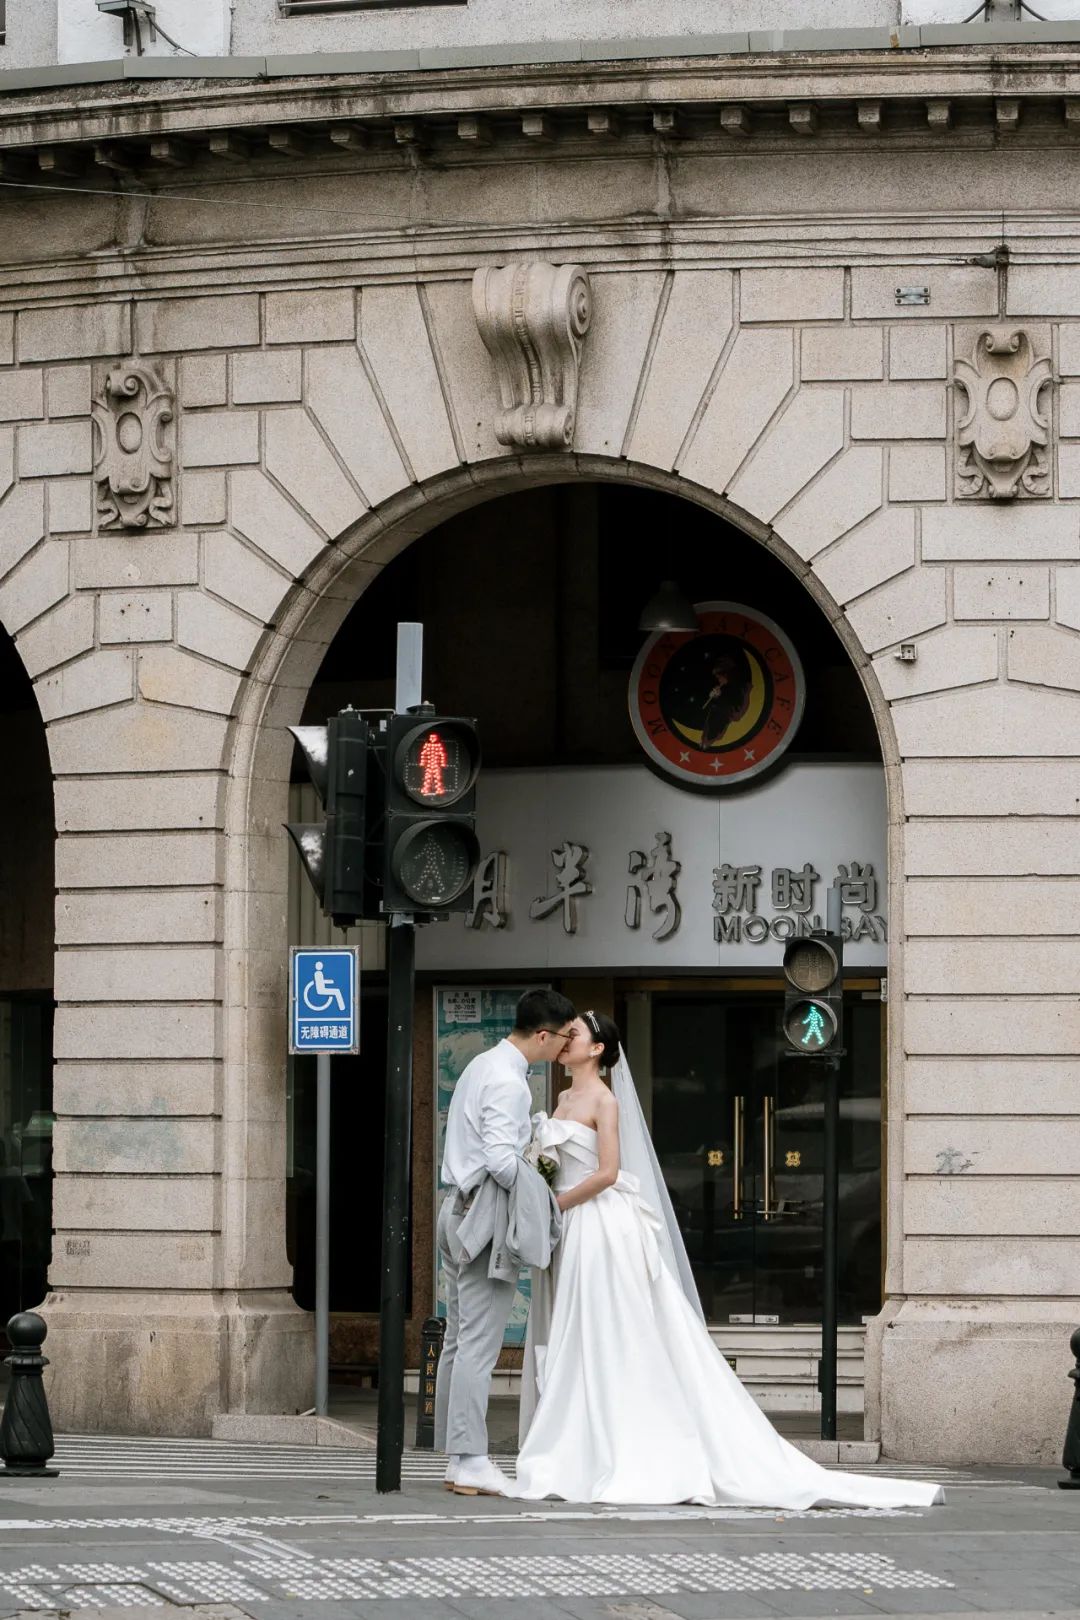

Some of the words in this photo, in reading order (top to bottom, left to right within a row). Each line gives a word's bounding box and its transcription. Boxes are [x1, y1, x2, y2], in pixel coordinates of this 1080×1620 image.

[763, 647, 792, 736] CAFE
[712, 861, 876, 914] 新时尚
[713, 914, 821, 943] MOON
[300, 1025, 348, 1040] 无障碍通道
